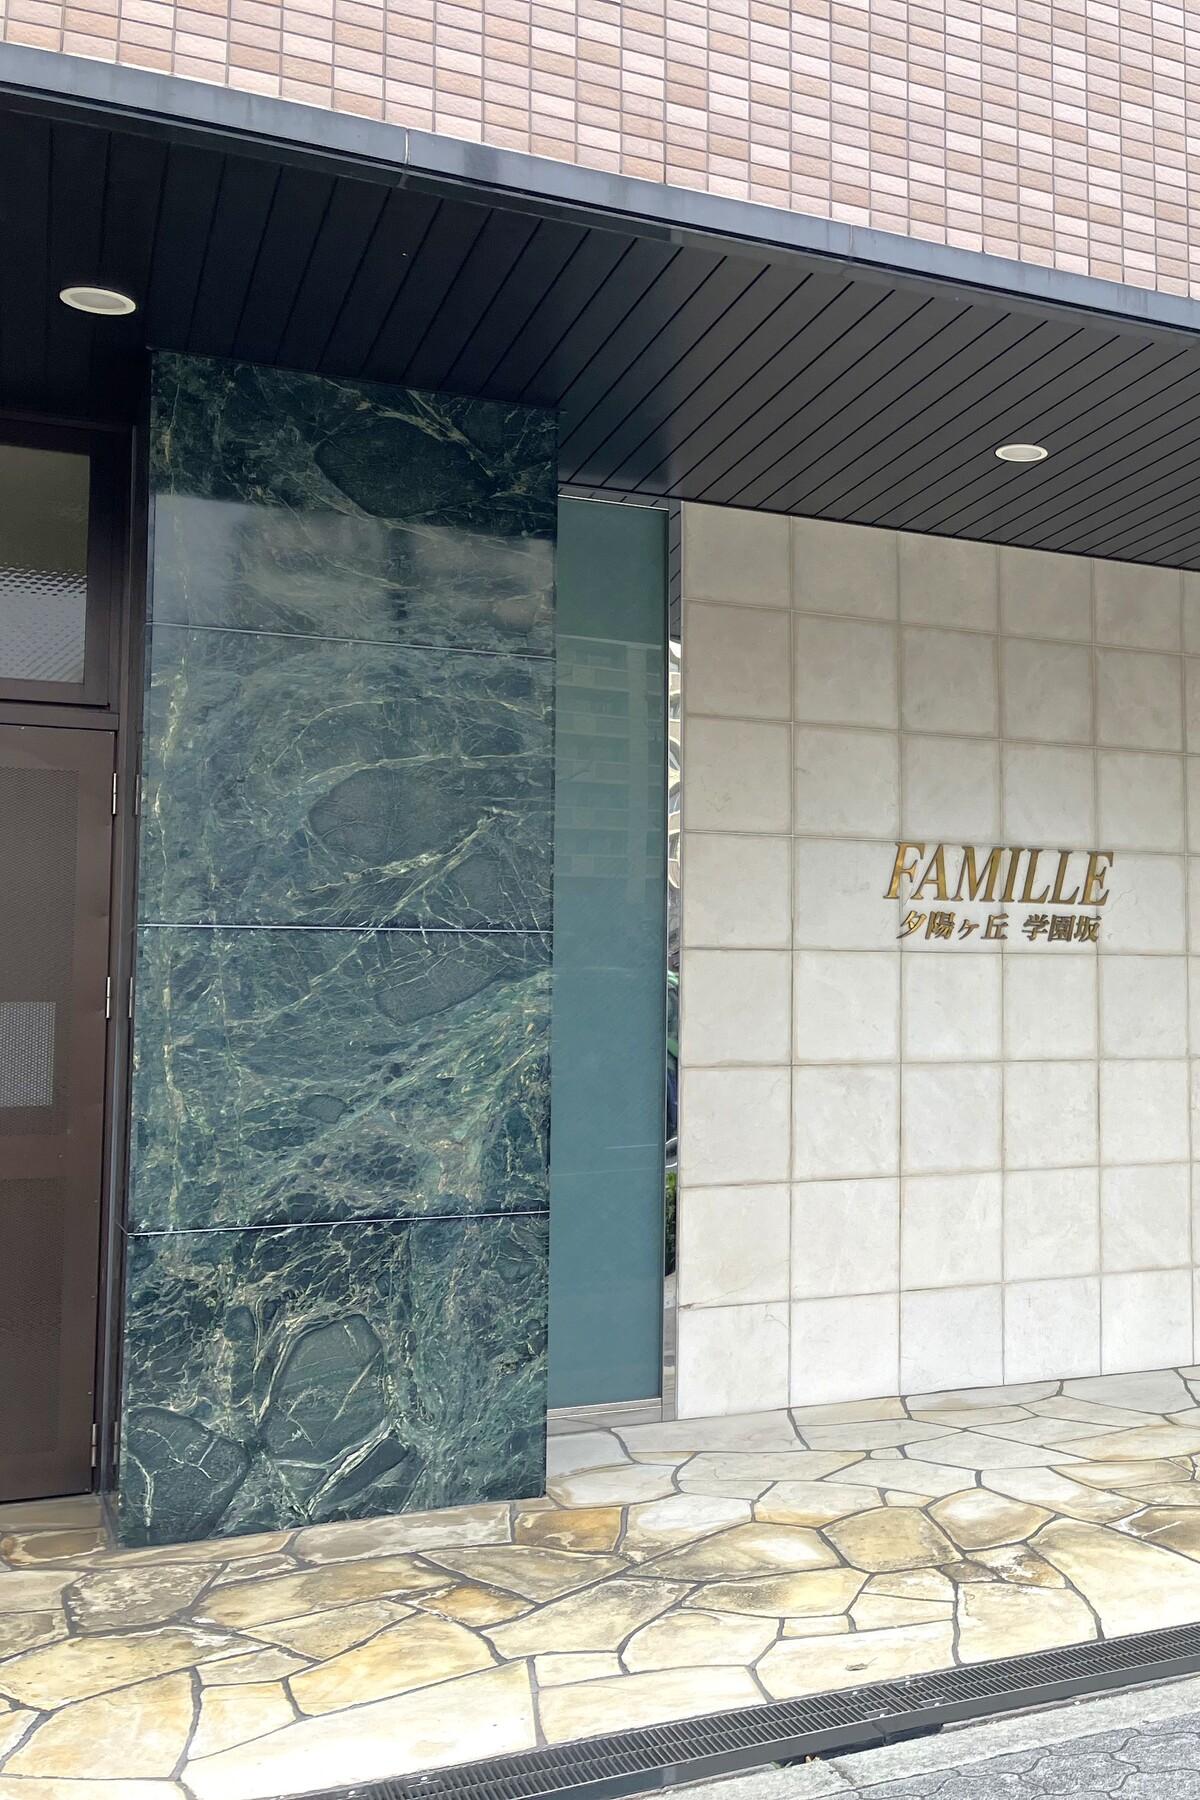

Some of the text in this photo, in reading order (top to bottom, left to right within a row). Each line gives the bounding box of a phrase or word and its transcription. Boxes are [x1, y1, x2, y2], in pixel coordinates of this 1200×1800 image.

[883, 842, 1114, 906] FAMILLE
[896, 909, 1101, 942] 夕陽ヶ丘 学園坂
